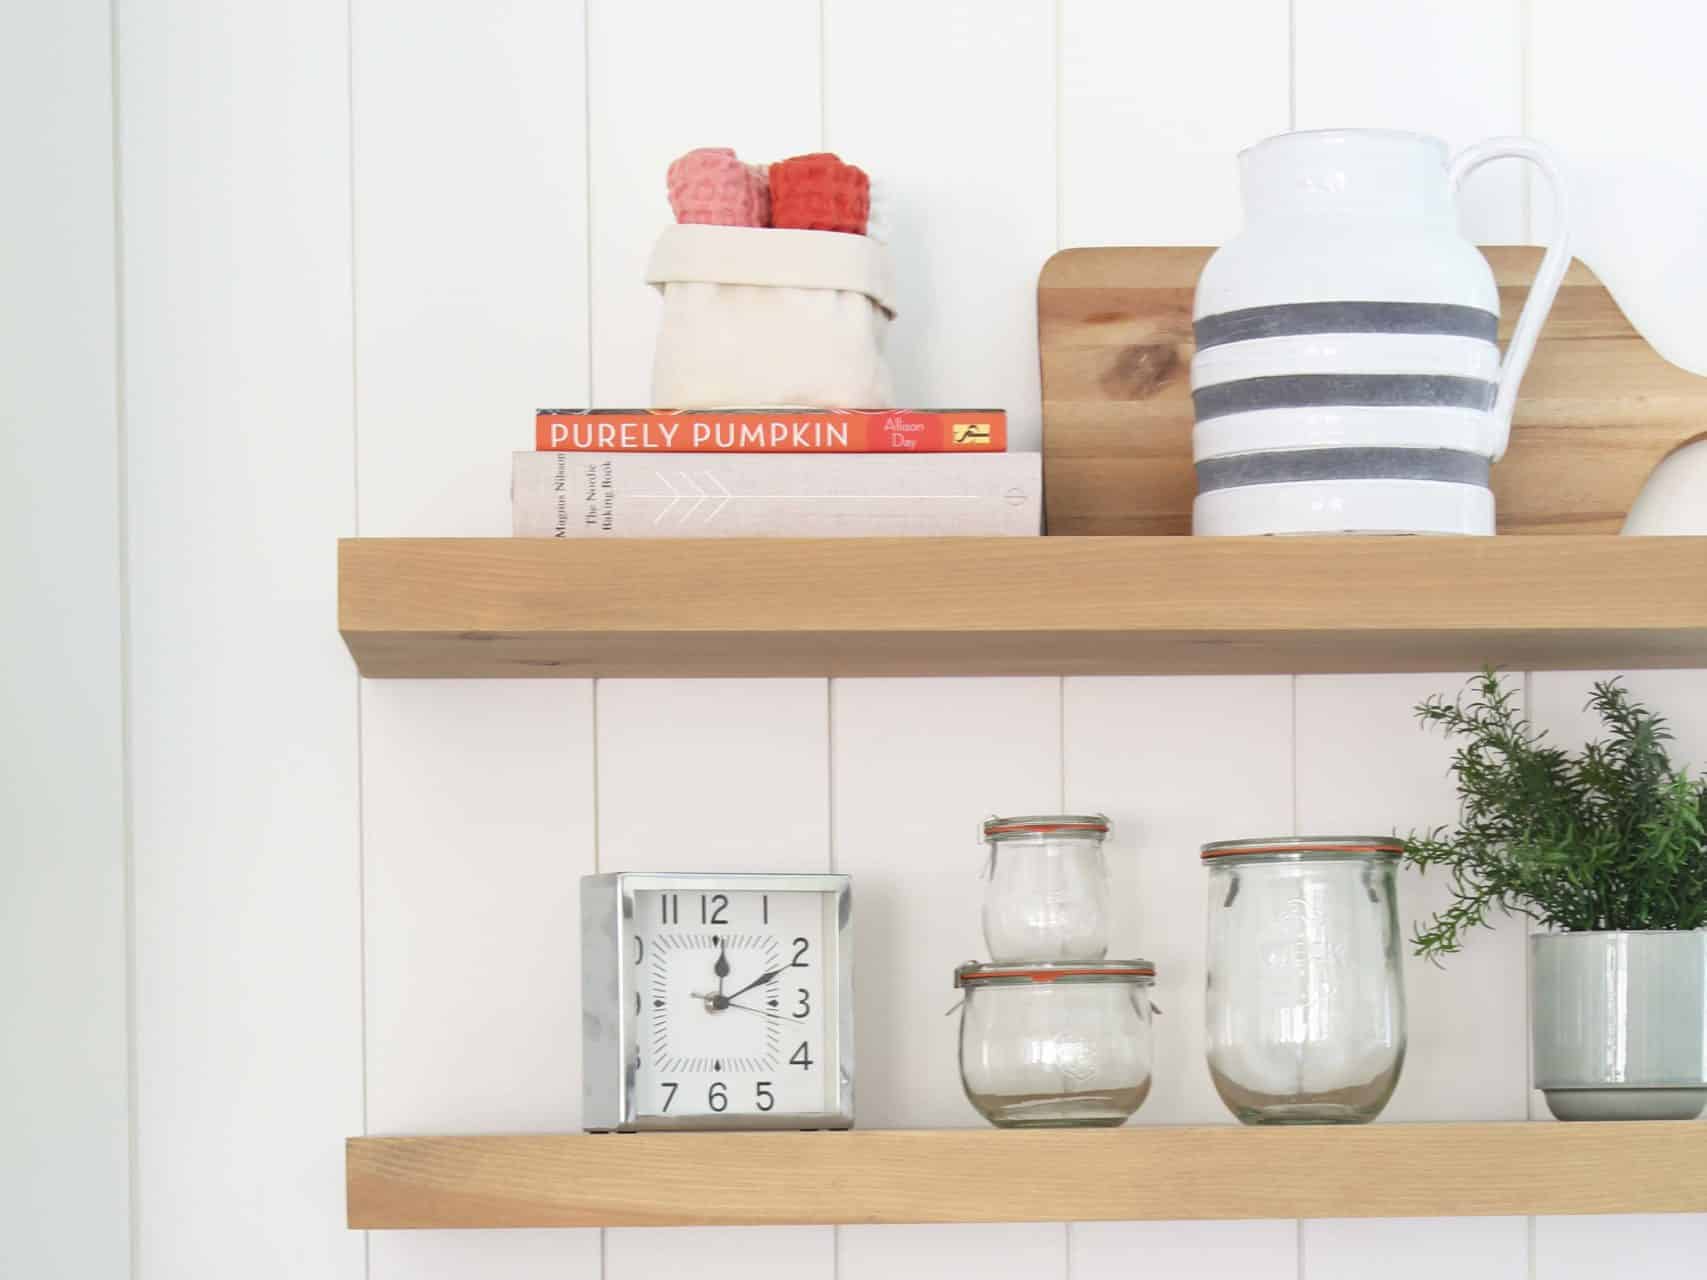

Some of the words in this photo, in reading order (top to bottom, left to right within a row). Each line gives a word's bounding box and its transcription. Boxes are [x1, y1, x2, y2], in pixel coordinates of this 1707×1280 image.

[550, 422, 681, 449] PURELY
[692, 421, 850, 448] PUMPKIN
[883, 416, 925, 432] Alison
[891, 432, 919, 450] Day
[585, 464, 597, 501] Nordic
[600, 460, 612, 489] Book
[585, 503, 598, 525] The
[600, 491, 615, 531] Baking
[661, 893, 679, 924] 11
[701, 893, 729, 924] 12
[762, 894, 769, 924] 1
[790, 937, 810, 967] 2
[791, 987, 811, 1018] 3
[788, 1040, 814, 1070] 4
[660, 1082, 679, 1112] 7
[707, 1081, 728, 1112] 6
[755, 1080, 775, 1111] 5
